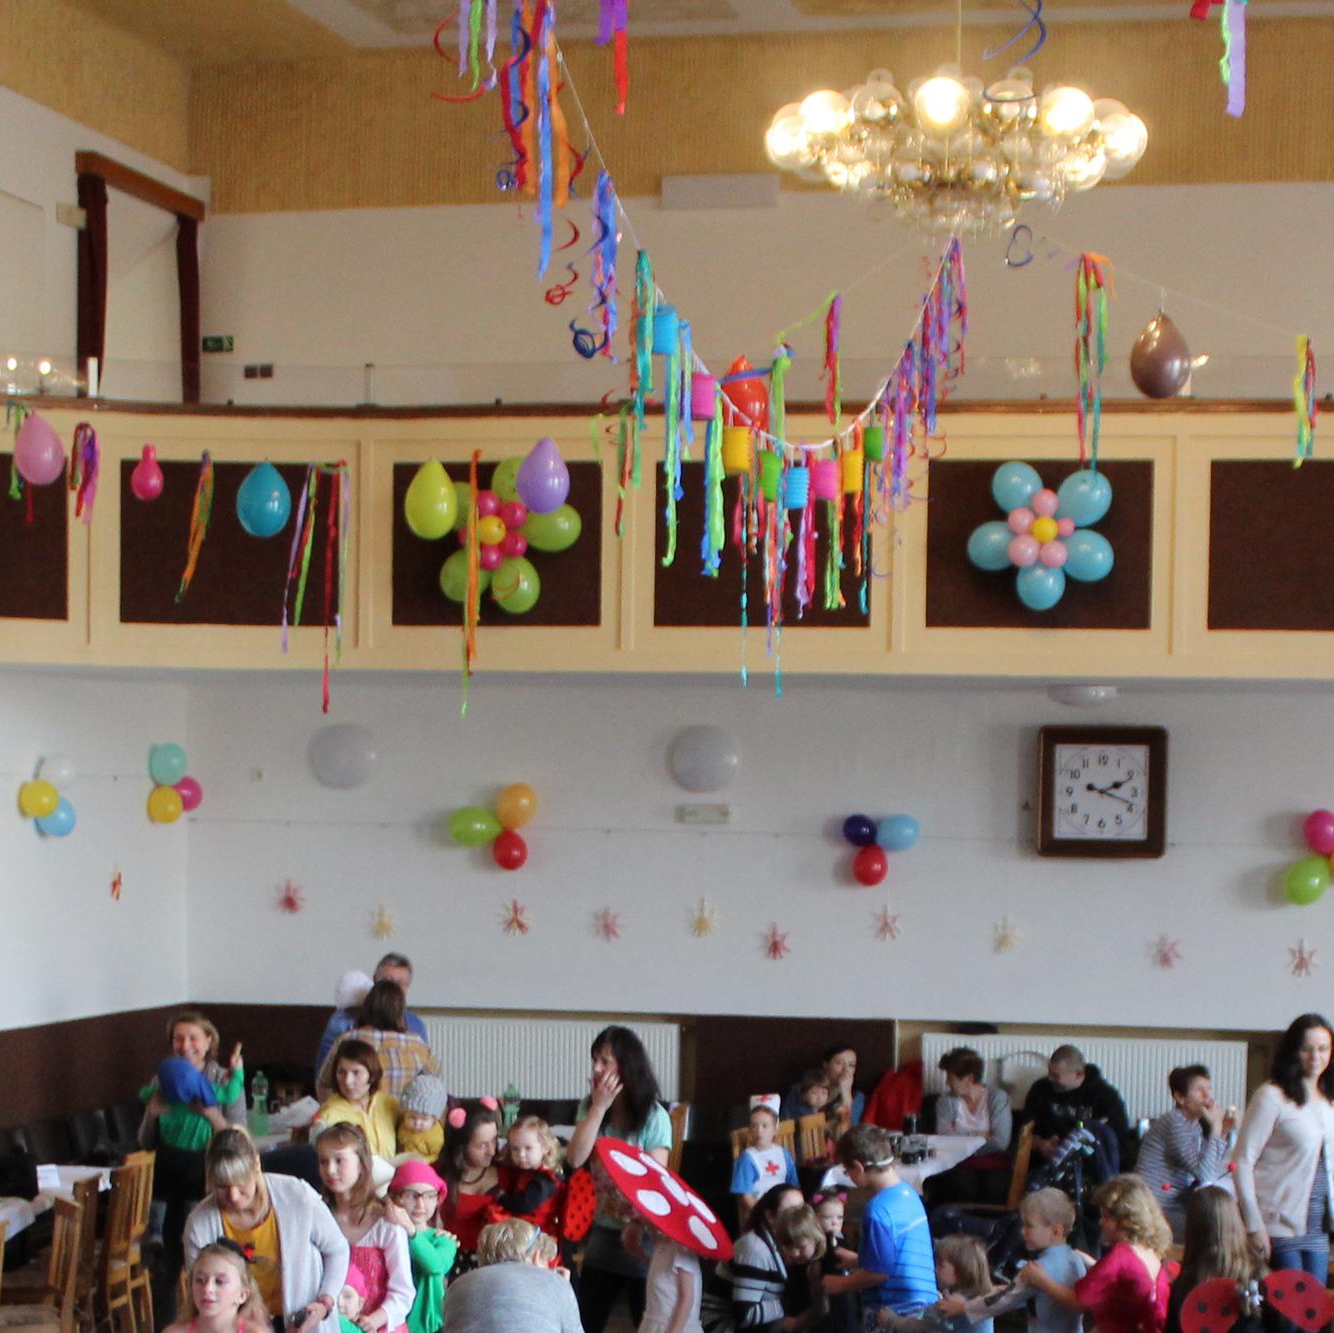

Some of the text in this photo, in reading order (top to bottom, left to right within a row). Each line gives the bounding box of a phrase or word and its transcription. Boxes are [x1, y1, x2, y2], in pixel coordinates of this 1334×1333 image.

[1082, 758, 1089, 768] 11
[1098, 754, 1109, 766] 12
[1070, 769, 1081, 780] 10
[1066, 786, 1073, 797] 9
[1131, 786, 1139, 798] 3
[1070, 803, 1077, 813] 8
[1126, 803, 1133, 814] 4
[1083, 814, 1090, 825] 7
[1098, 817, 1107, 829] 6
[1115, 814, 1123, 825] 5
